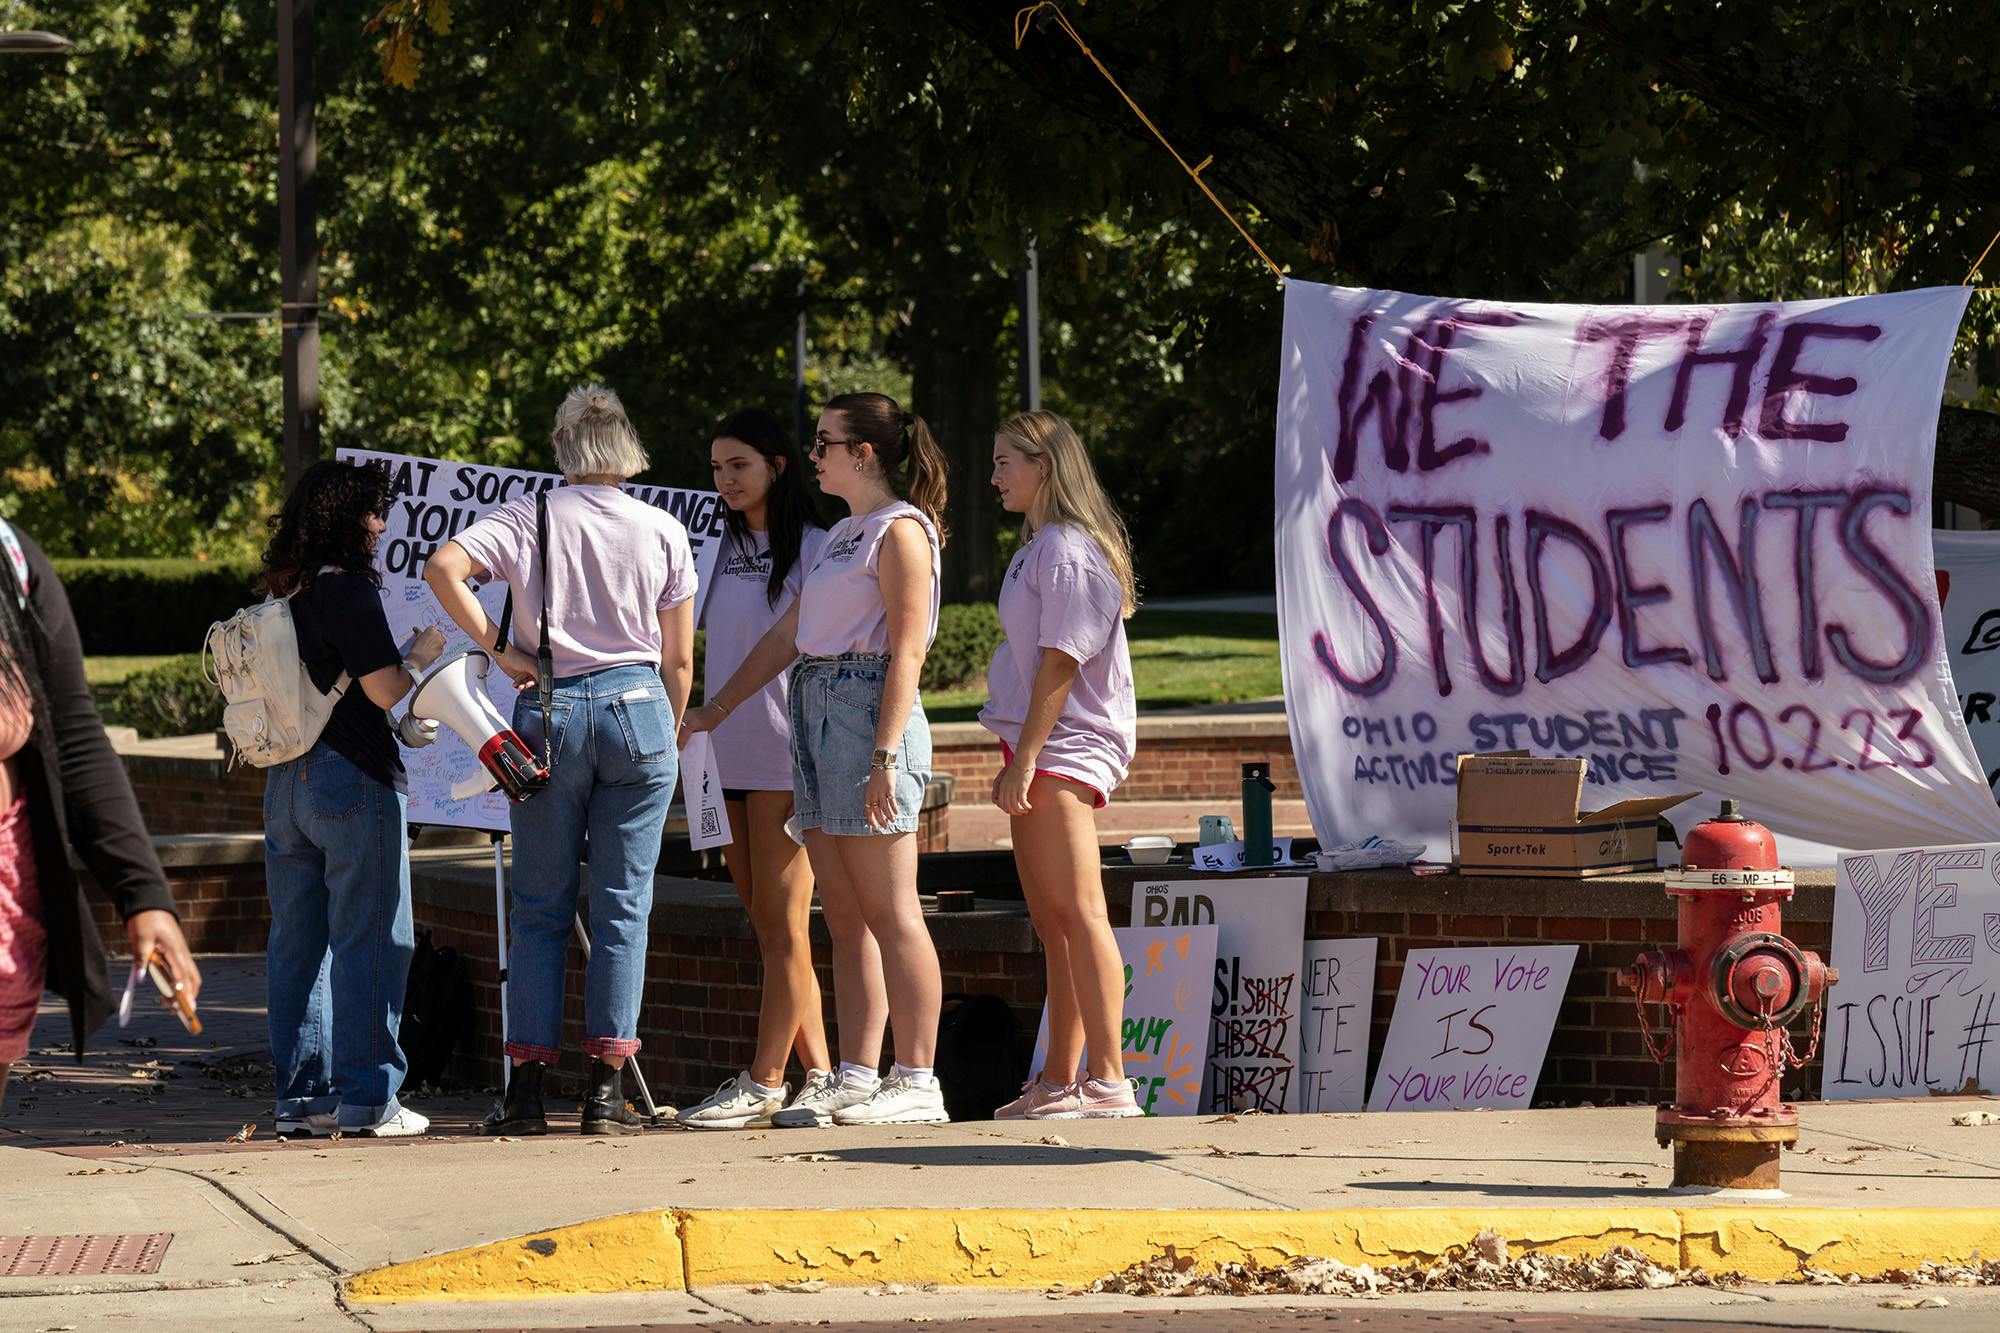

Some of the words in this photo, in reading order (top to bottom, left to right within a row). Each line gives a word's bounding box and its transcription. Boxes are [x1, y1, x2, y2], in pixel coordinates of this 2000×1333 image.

[1334, 308, 1521, 484] WE
[1580, 308, 1882, 442] THE
[1312, 487, 1931, 696] STUDENTS
[1342, 710, 1438, 747] OHIO
[1469, 707, 1687, 750] STUDENT
[1706, 701, 1936, 775] 10.2.23
[1487, 843, 1547, 856] Sport-Tek
[1145, 884, 1169, 895] OHIO'S
[1711, 873, 1727, 885] E6
[1743, 873, 1760, 885] MP
[1844, 849, 2000, 974] YE
[1242, 974, 1294, 1016] SB117
[1417, 956, 1471, 1000] YOUR
[1495, 954, 1550, 992] Vote
[1906, 967, 1988, 997] on
[1212, 1017, 1288, 1060] HB322
[1431, 1004, 1497, 1060] IS
[1833, 994, 1940, 1088] ISSUE
[1386, 1066, 1457, 1111] YOUR
[1463, 1064, 1528, 1101] Voice
